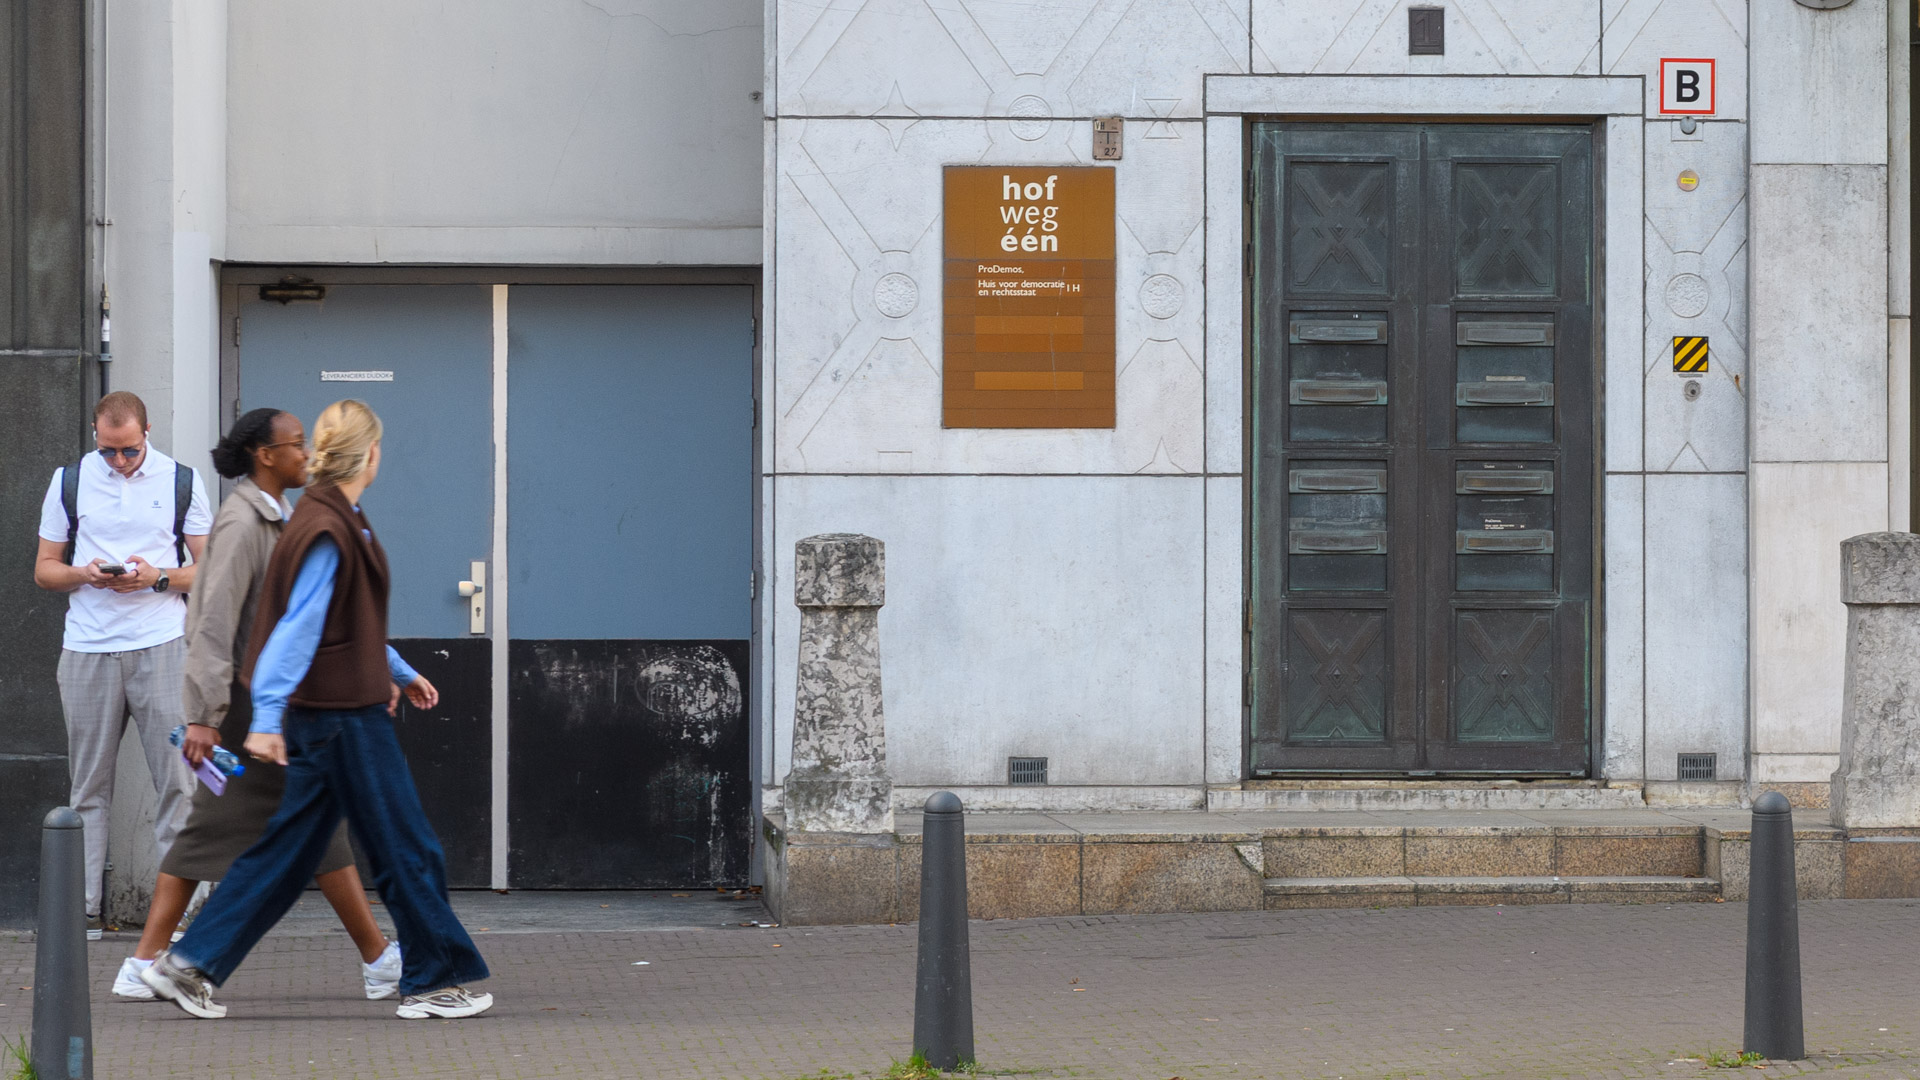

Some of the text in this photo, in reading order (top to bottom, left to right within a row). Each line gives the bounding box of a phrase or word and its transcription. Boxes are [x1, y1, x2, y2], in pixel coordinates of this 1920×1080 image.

[1676, 69, 1700, 102] B
[1003, 175, 1058, 200] hof
[1000, 206, 1059, 232] weg
[1000, 227, 1058, 252] één
[978, 264, 1025, 274] ProDemos,
[978, 280, 1065, 288] Huis voor democratie
[978, 288, 1036, 296] en rechtsstaat
[1072, 284, 1080, 292] H
